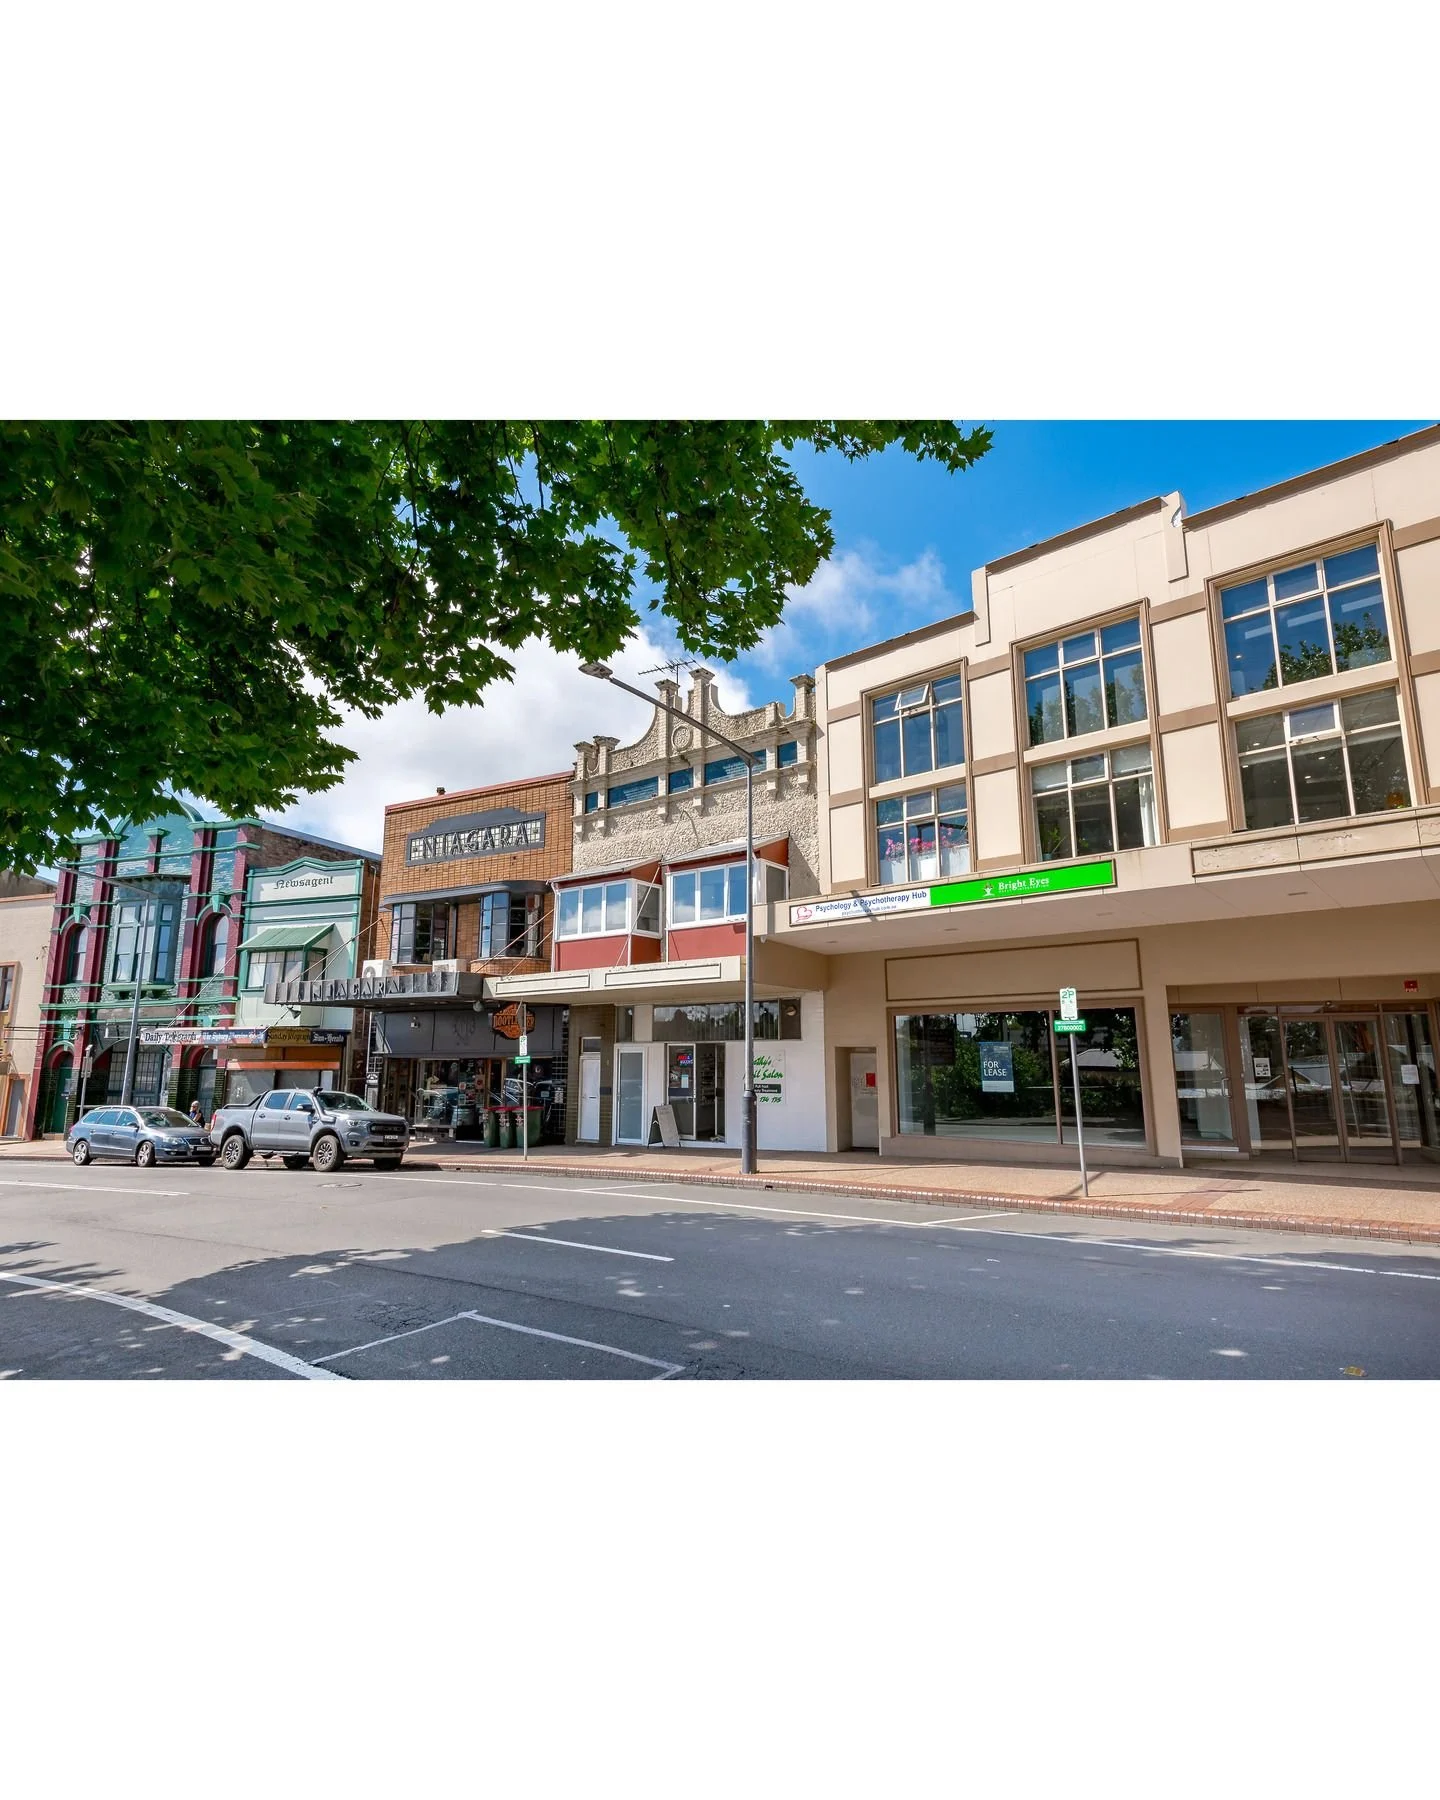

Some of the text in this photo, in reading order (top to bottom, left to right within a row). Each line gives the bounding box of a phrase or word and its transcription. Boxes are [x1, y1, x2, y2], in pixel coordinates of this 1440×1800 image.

[422, 821, 530, 859] NIAGARA
[273, 876, 333, 890] Newsagent
[998, 879, 1026, 891] Bright
[1029, 877, 1049, 888] Eyes
[815, 901, 851, 912] Psychology
[860, 893, 910, 907] Psychotherapy
[912, 890, 927, 900] Hub
[312, 980, 399, 1000] NIAGARA
[1062, 990, 1075, 999] 2P
[145, 1032, 162, 1043] Daily
[983, 1060, 999, 1069] FOR
[761, 1069, 784, 1080] Salon
[983, 1068, 1007, 1077] LEASE
